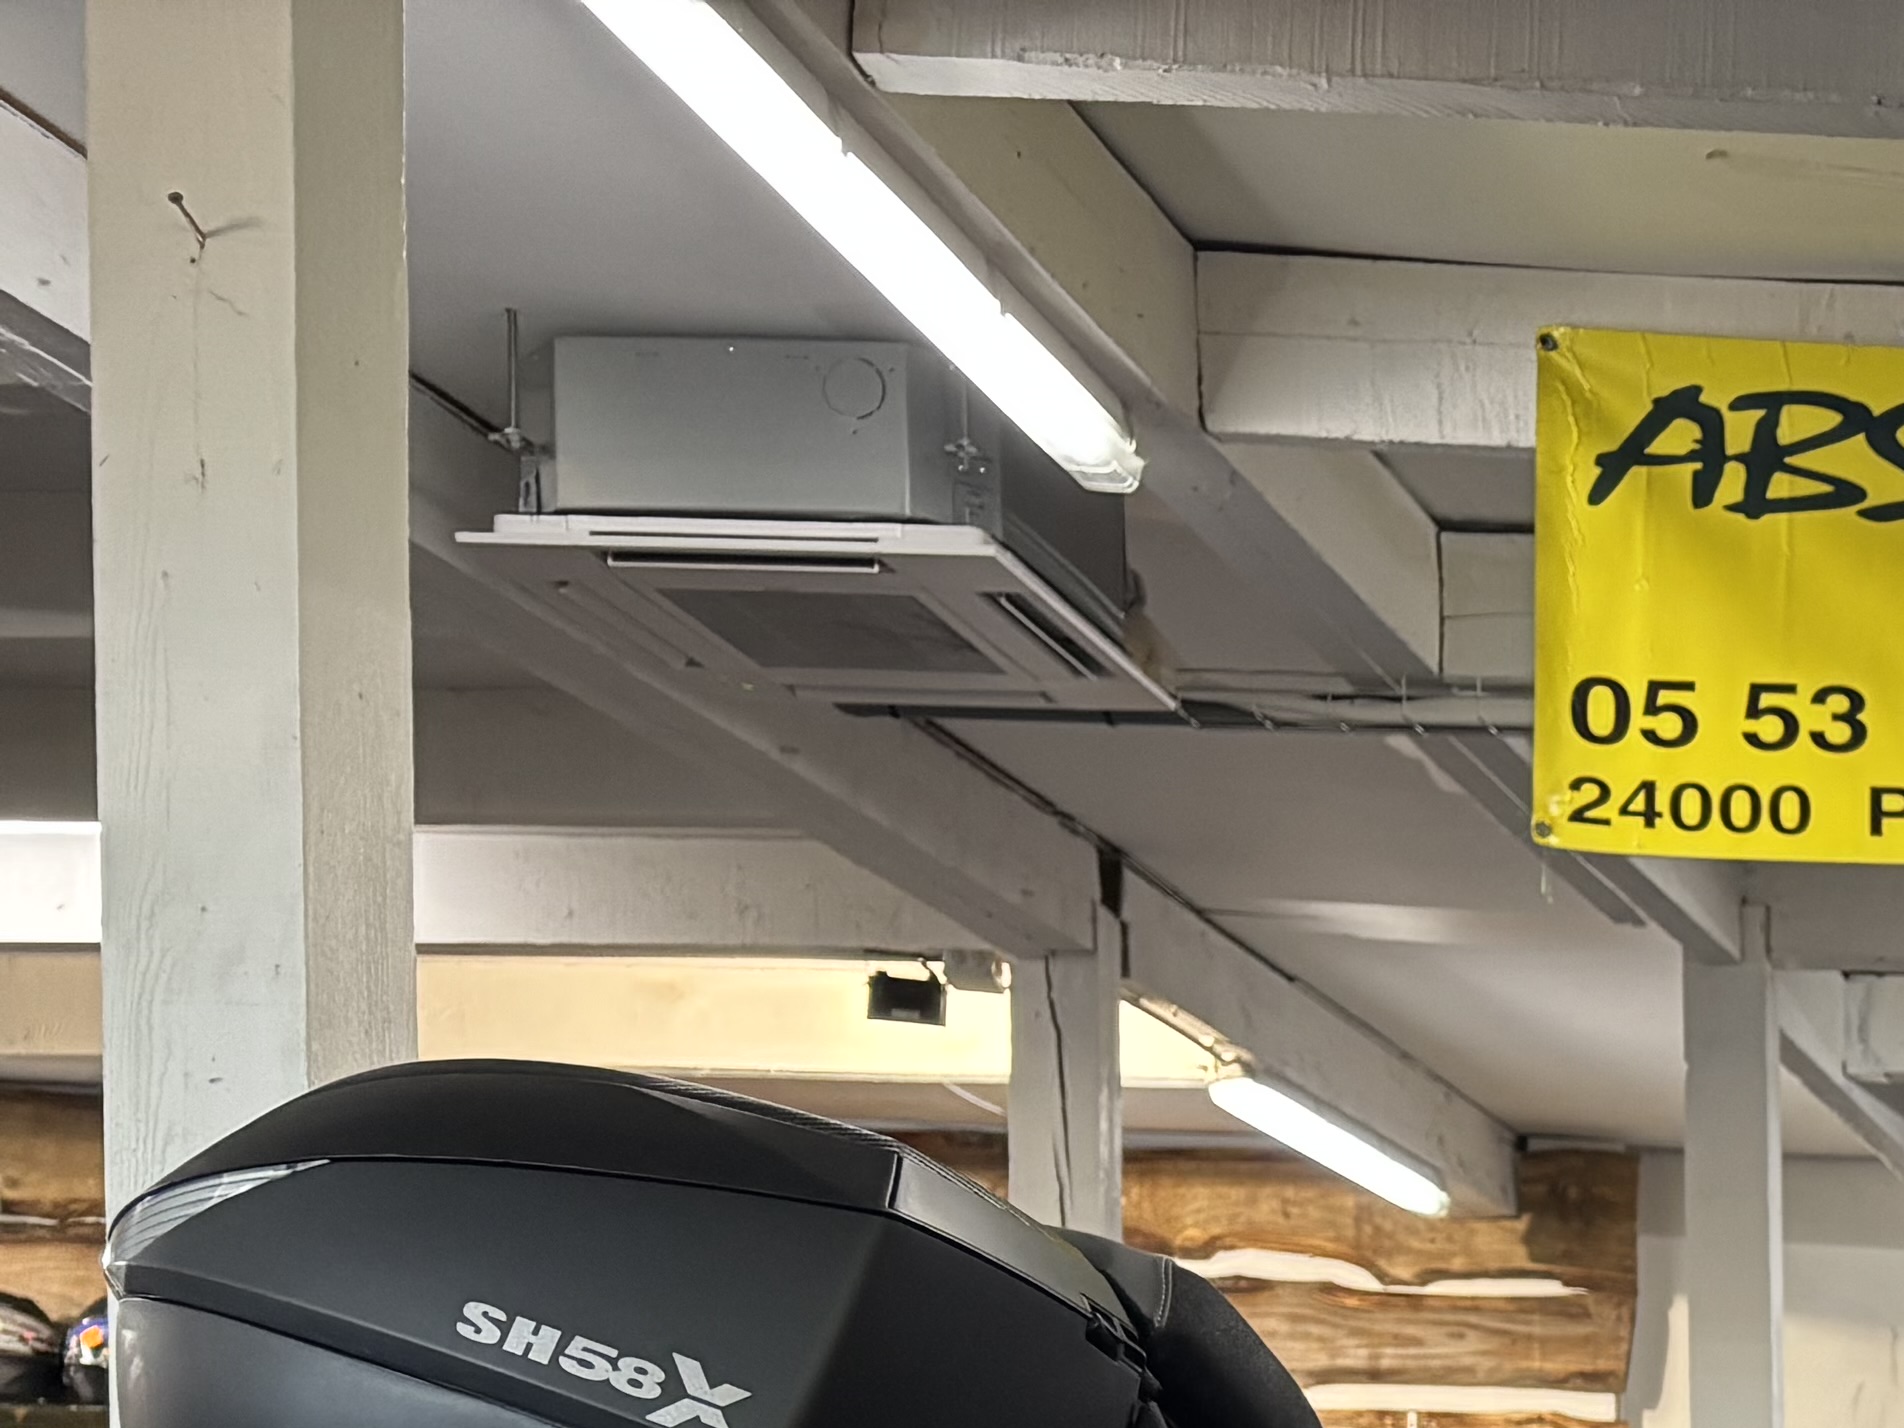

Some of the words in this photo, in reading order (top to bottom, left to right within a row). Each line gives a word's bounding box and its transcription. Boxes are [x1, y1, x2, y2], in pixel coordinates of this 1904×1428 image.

[1570, 677, 1699, 748] 05
[1743, 683, 1868, 753] 53
[1568, 777, 1812, 835] 24000
